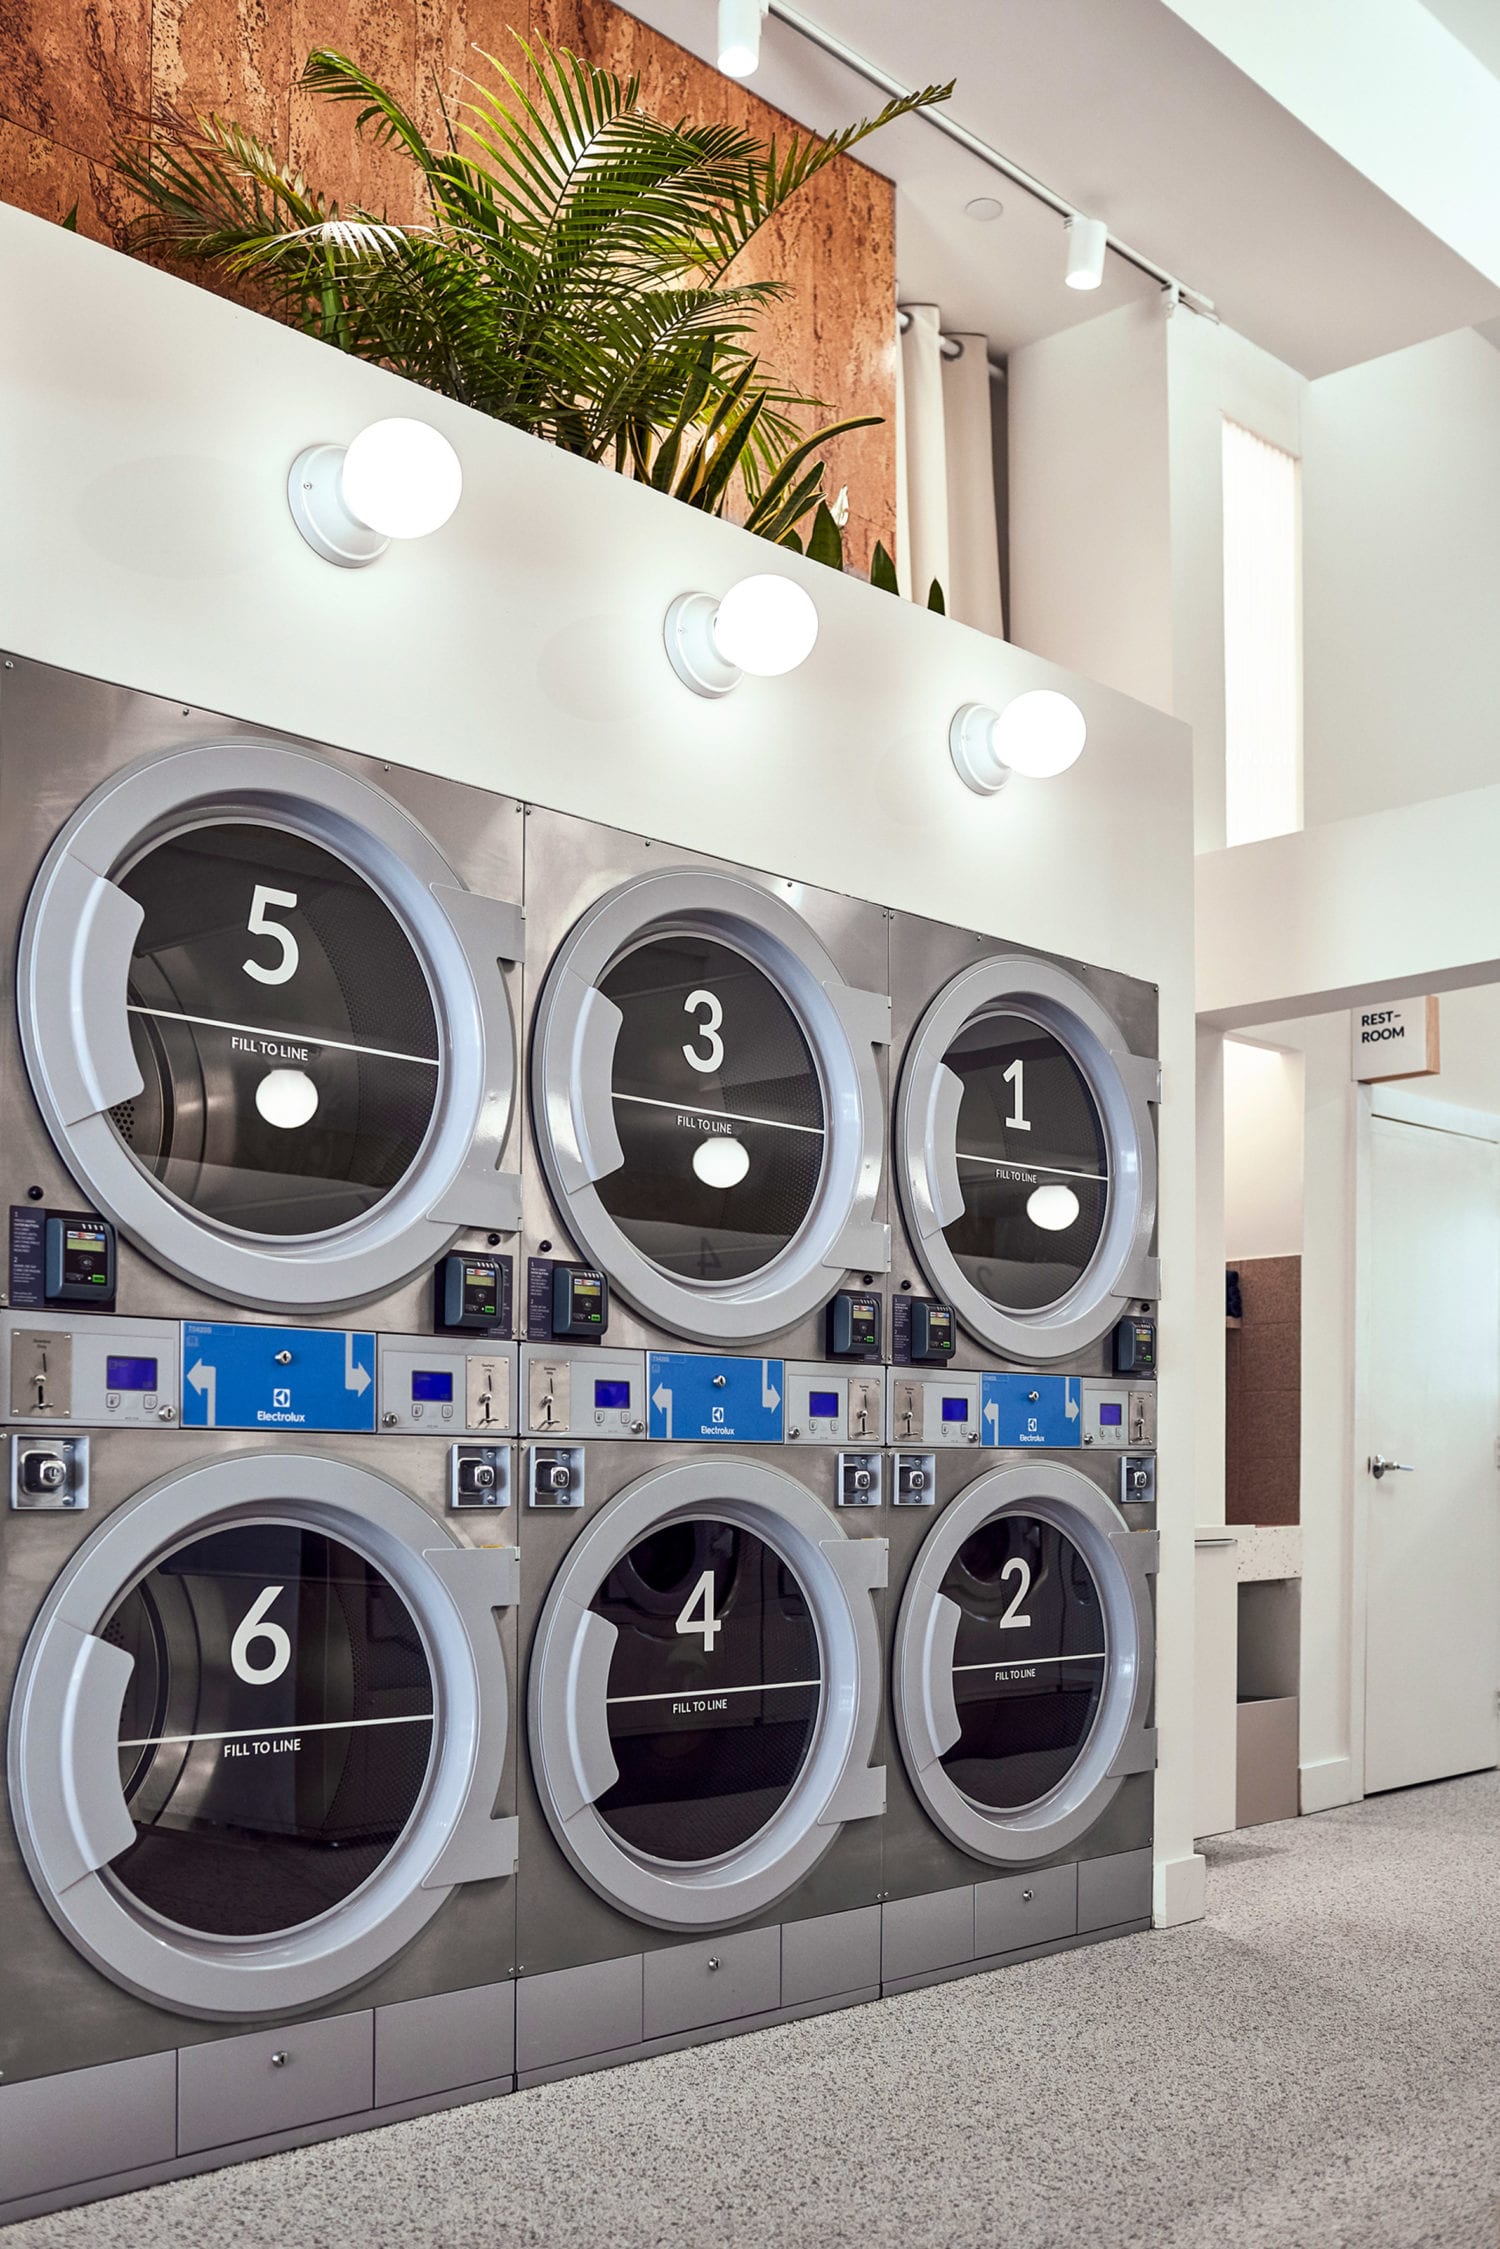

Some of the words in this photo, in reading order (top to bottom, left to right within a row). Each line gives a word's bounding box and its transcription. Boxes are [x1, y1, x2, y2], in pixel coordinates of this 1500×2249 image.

[243, 885, 298, 985] 5
[1361, 1010, 1401, 1027] REST-
[683, 990, 724, 1073] 3
[1361, 1026, 1405, 1043] ROOM
[231, 1036, 258, 1053] FILL
[259, 1040, 279, 1056] TO
[280, 1044, 309, 1062] LINE
[1003, 1059, 1031, 1132] 1
[677, 1115, 697, 1129] FILL
[697, 1118, 711, 1131] TO
[711, 1121, 732, 1135] LINE
[995, 1168, 1010, 1180] FILL
[1010, 1170, 1021, 1181] TO
[1021, 1172, 1037, 1184] LINE
[257, 1410, 306, 1422] Electrolux
[700, 1425, 735, 1435] Electrolux
[1019, 1434, 1045, 1442] Electrolux
[999, 1557, 1031, 1629] 2
[675, 1570, 722, 1652] 4
[231, 1586, 291, 1685] 6
[995, 1671, 1009, 1681] FILL
[1009, 1669, 1020, 1679] TO
[1020, 1668, 1036, 1679] LINE
[672, 1702, 692, 1714] FILL
[692, 1700, 706, 1712] TO
[707, 1698, 728, 1711] LINE
[224, 1743, 250, 1758] FILL
[251, 1741, 271, 1755] TO
[272, 1738, 301, 1753] LINE
